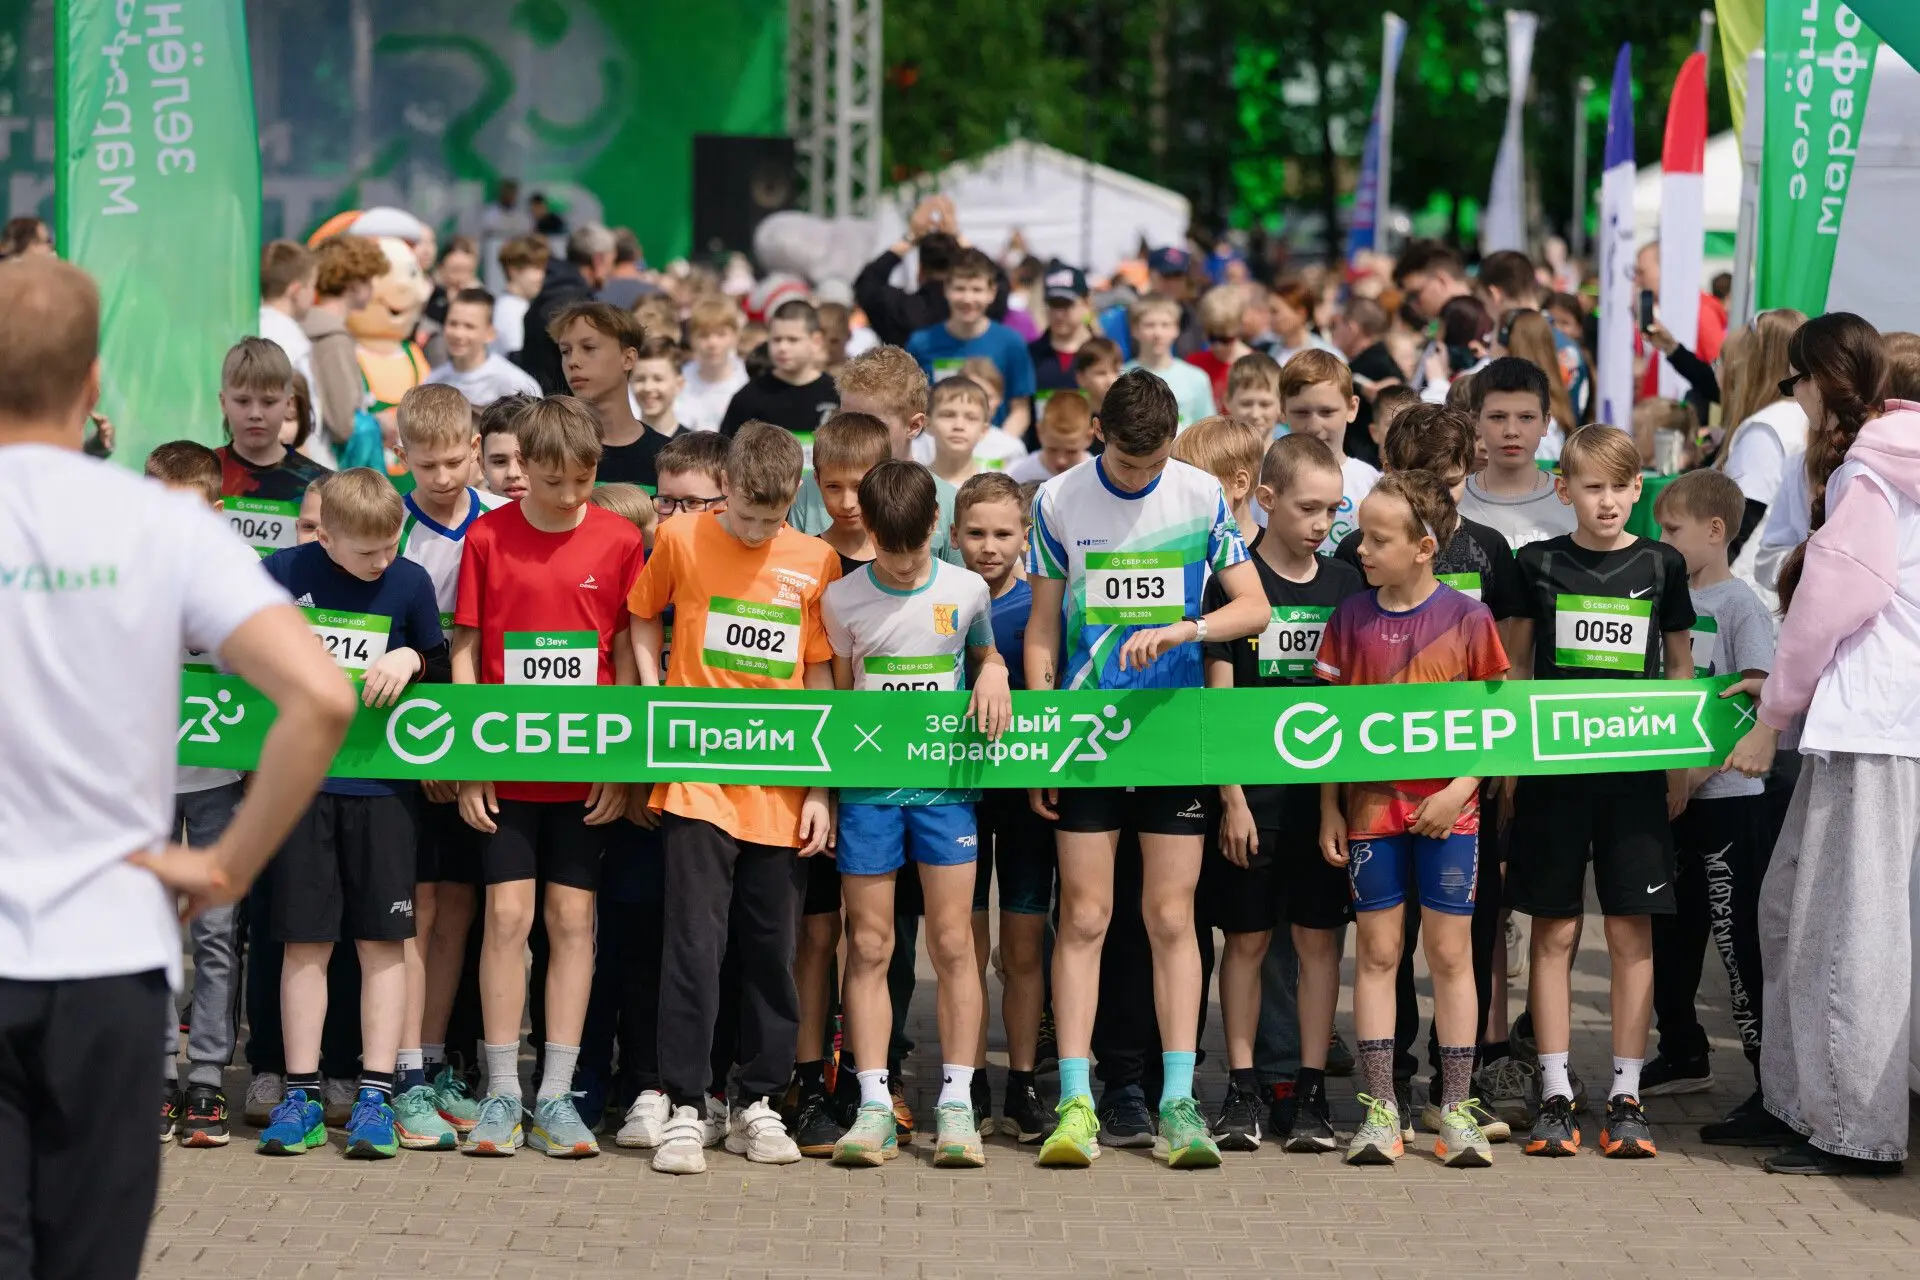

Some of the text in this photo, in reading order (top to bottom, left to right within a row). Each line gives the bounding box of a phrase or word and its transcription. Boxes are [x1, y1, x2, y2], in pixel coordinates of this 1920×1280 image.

[1105, 576, 1164, 599] 0153
[328, 616, 366, 626] СБЕР KIDS
[1301, 612, 1321, 620] Звук
[546, 638, 569, 647] Звук
[726, 623, 785, 653] 0082
[1575, 619, 1633, 645] 0058
[523, 656, 581, 680] 0908
[471, 711, 633, 755] СБЕР
[926, 706, 1061, 733] зелый
[1358, 708, 1518, 755] СБЕР
[1552, 706, 1677, 747] Прайм
[669, 719, 795, 757] Прайм
[907, 737, 1048, 767] марафон
